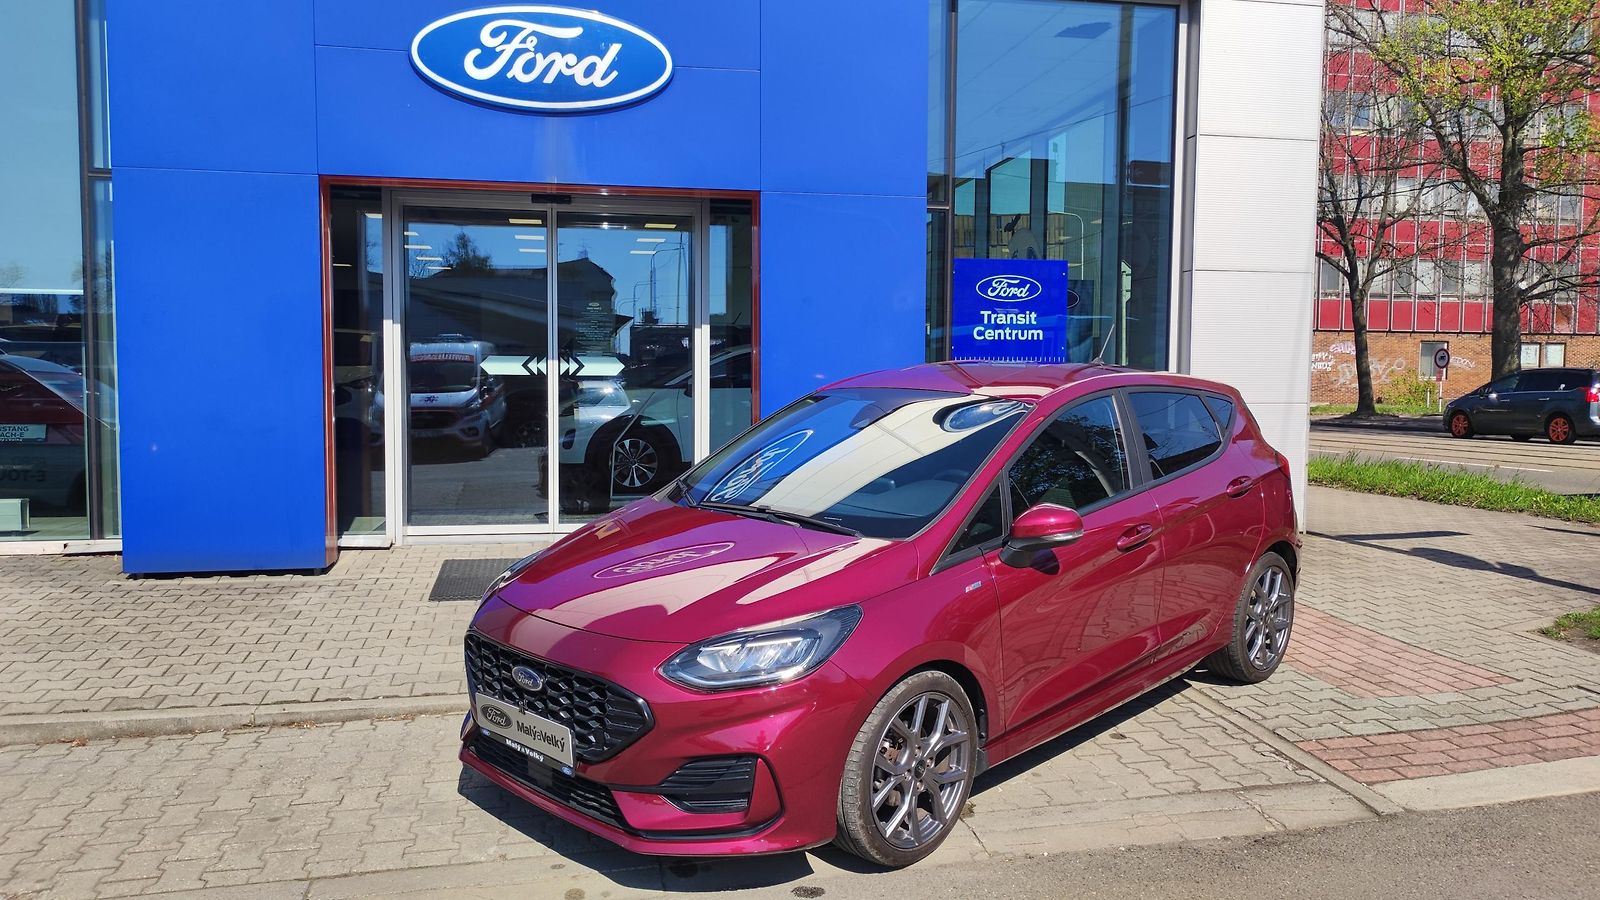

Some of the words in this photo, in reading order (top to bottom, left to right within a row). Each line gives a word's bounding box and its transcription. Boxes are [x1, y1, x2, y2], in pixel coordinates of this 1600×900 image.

[463, 19, 622, 88] Ford
[987, 278, 1031, 297] Ford
[980, 310, 1037, 325] Transit
[973, 326, 1044, 341] Centrum
[517, 670, 534, 687] Ford
[486, 707, 507, 726] Ford
